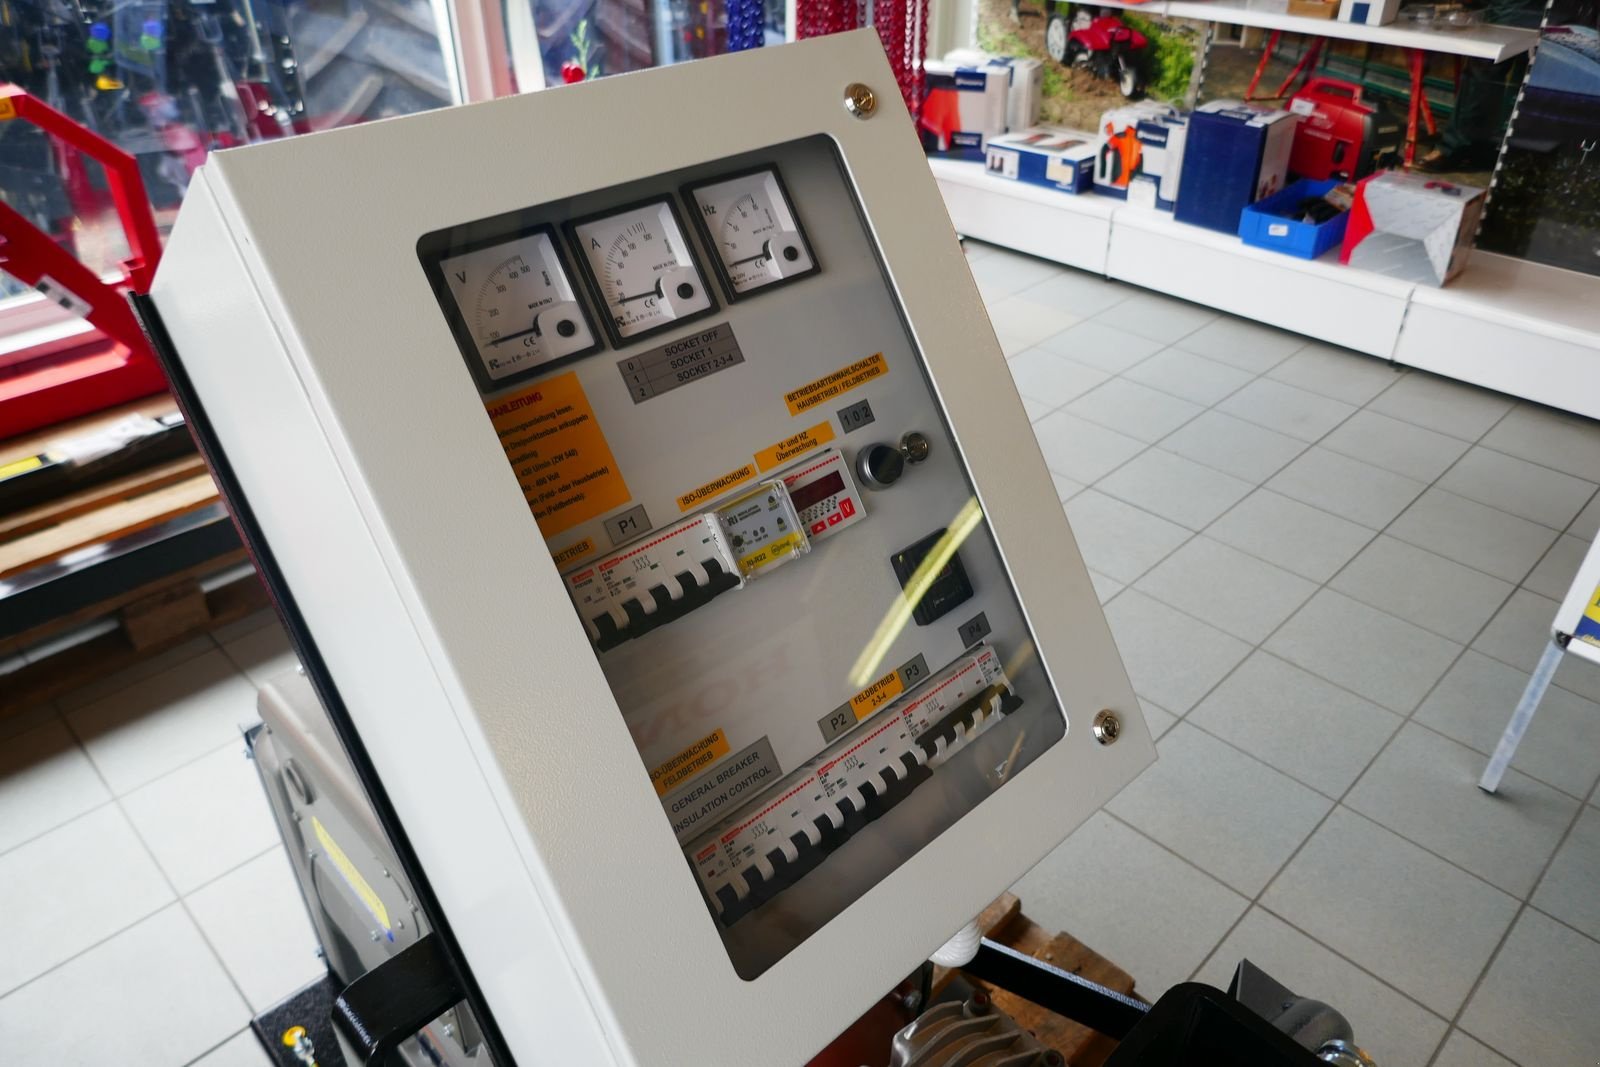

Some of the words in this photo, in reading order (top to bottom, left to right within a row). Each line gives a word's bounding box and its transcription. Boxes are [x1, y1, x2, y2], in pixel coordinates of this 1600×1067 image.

[702, 204, 717, 216] Hz
[591, 238, 601, 250] A
[456, 271, 466, 284] V
[520, 264, 531, 274] 500
[627, 362, 634, 371] 0
[665, 336, 701, 357] SOCKET
[702, 330, 719, 343] OFF
[670, 350, 706, 370] SOCKET
[640, 388, 646, 397] 2
[676, 361, 712, 382] SOCKET
[712, 353, 734, 368] 2-3-4
[787, 353, 881, 403] BETRIEBSARTENWAHLSCHALTER
[796, 385, 839, 411] HAUSBETRIEB
[842, 366, 880, 391] FELDBETRIEB
[862, 406, 871, 418] 2
[776, 438, 819, 462] Überwachung
[778, 441, 786, 451] V-
[787, 435, 799, 447] und
[798, 431, 809, 442] HZ
[681, 466, 750, 506] ISO-ÜBERWACHUNG
[617, 516, 637, 534] P1
[967, 622, 982, 637] P4
[905, 663, 921, 681] P3
[854, 673, 896, 706] FELDBETRIEB
[871, 692, 888, 706] 2-3-4
[829, 712, 848, 732] P2
[663, 751, 714, 789] FELDBETRIEB
[671, 781, 718, 814] GENERAL
[716, 751, 760, 785] BREAKER
[728, 765, 772, 798] CONTROL
